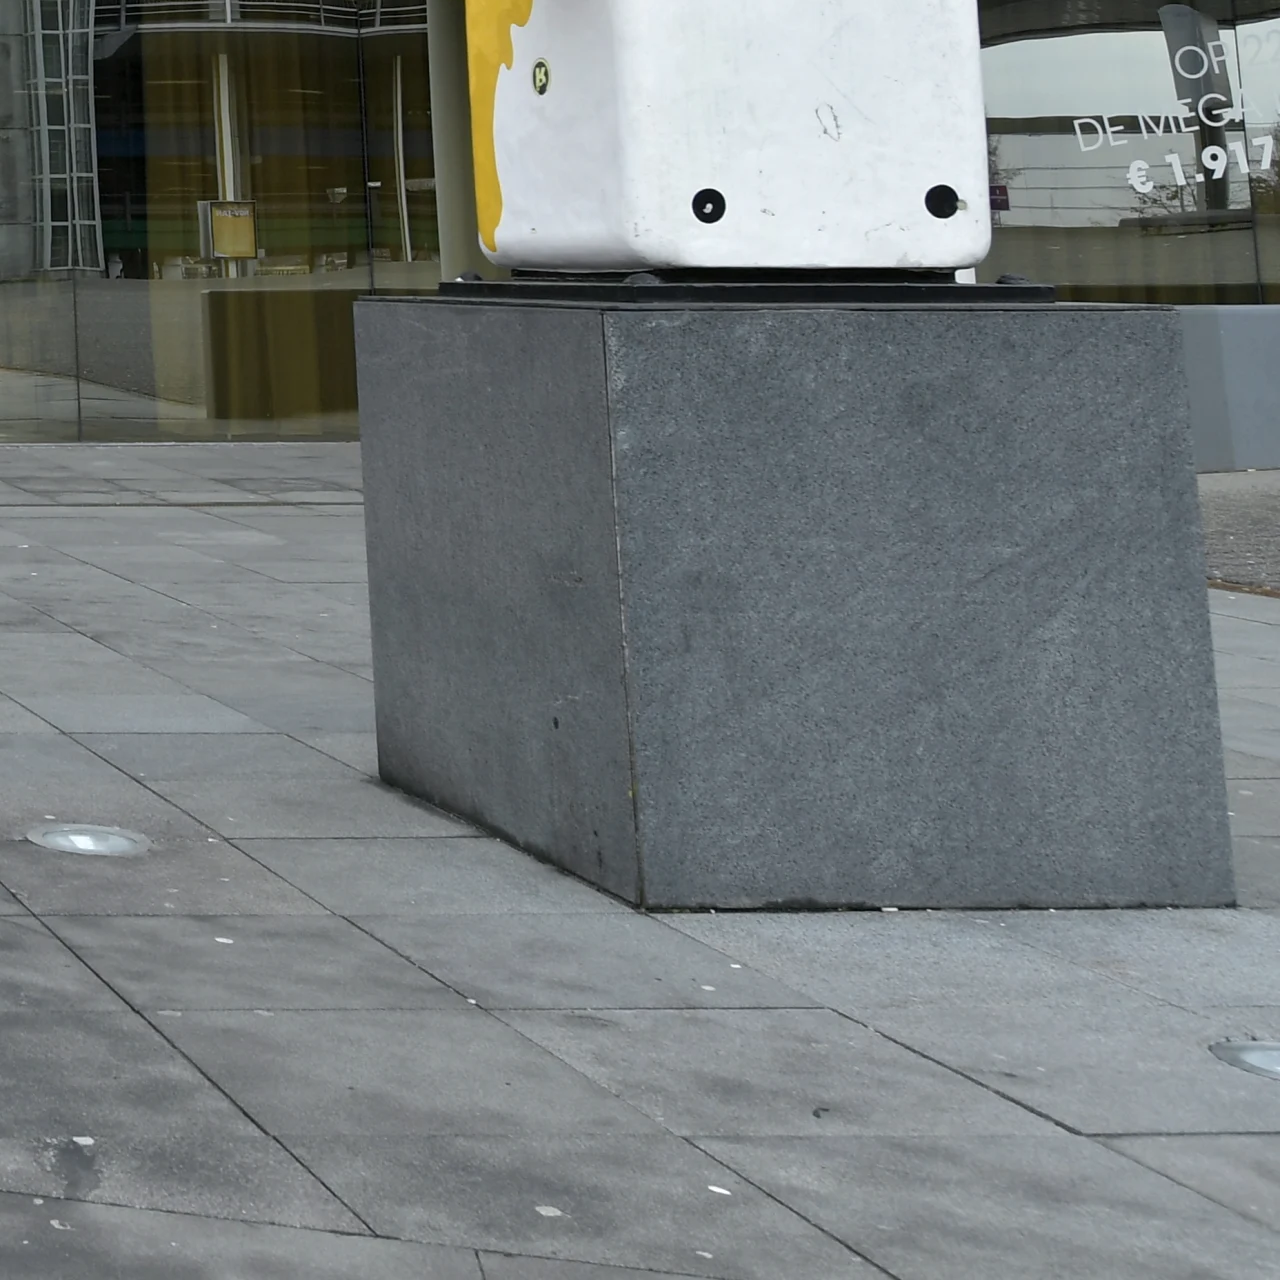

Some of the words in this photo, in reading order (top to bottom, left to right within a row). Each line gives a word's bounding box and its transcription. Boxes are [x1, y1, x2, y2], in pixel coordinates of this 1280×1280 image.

[1175, 40, 1228, 79] OP
[1073, 114, 1128, 152] DE
[1126, 159, 1154, 193] €
